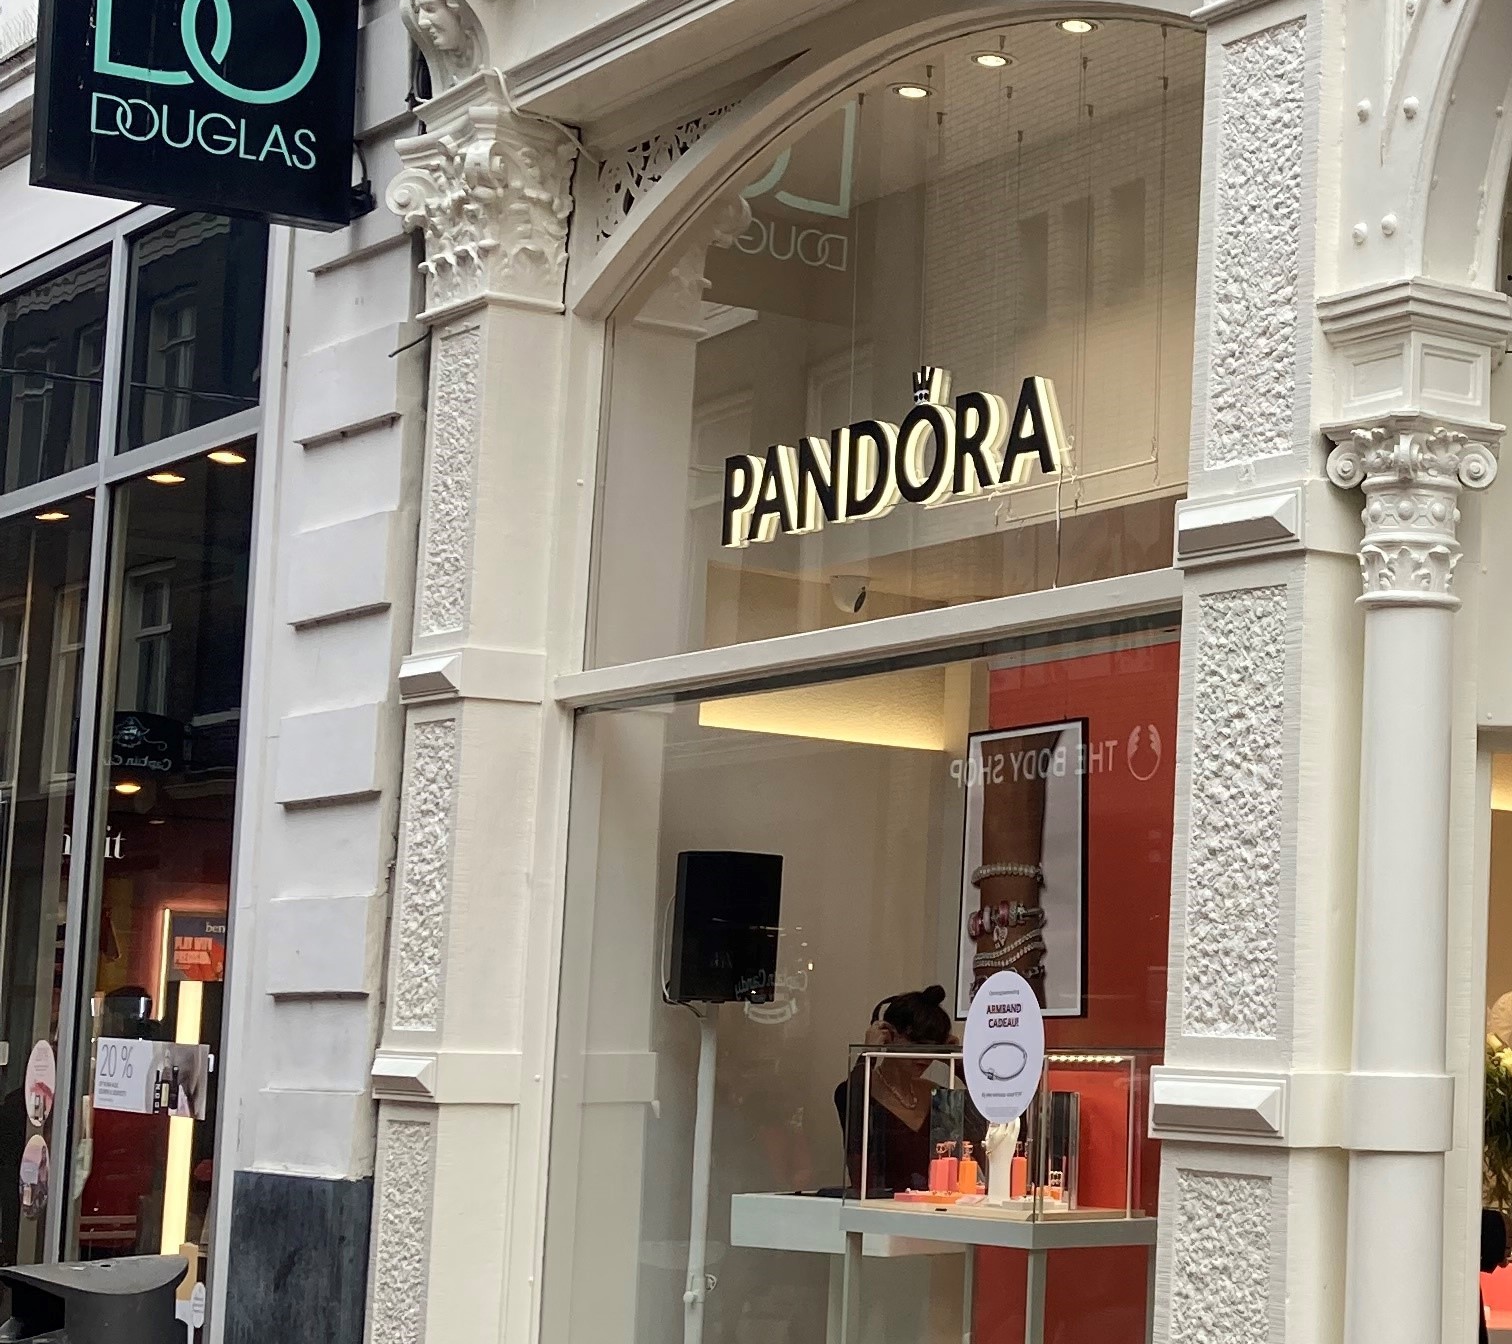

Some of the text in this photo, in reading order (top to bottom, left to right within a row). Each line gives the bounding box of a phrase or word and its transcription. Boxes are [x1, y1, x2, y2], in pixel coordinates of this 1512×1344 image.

[90, 92, 316, 170] DOUGLAS
[720, 374, 1064, 548] PANDORA
[100, 1044, 117, 1078] 20
